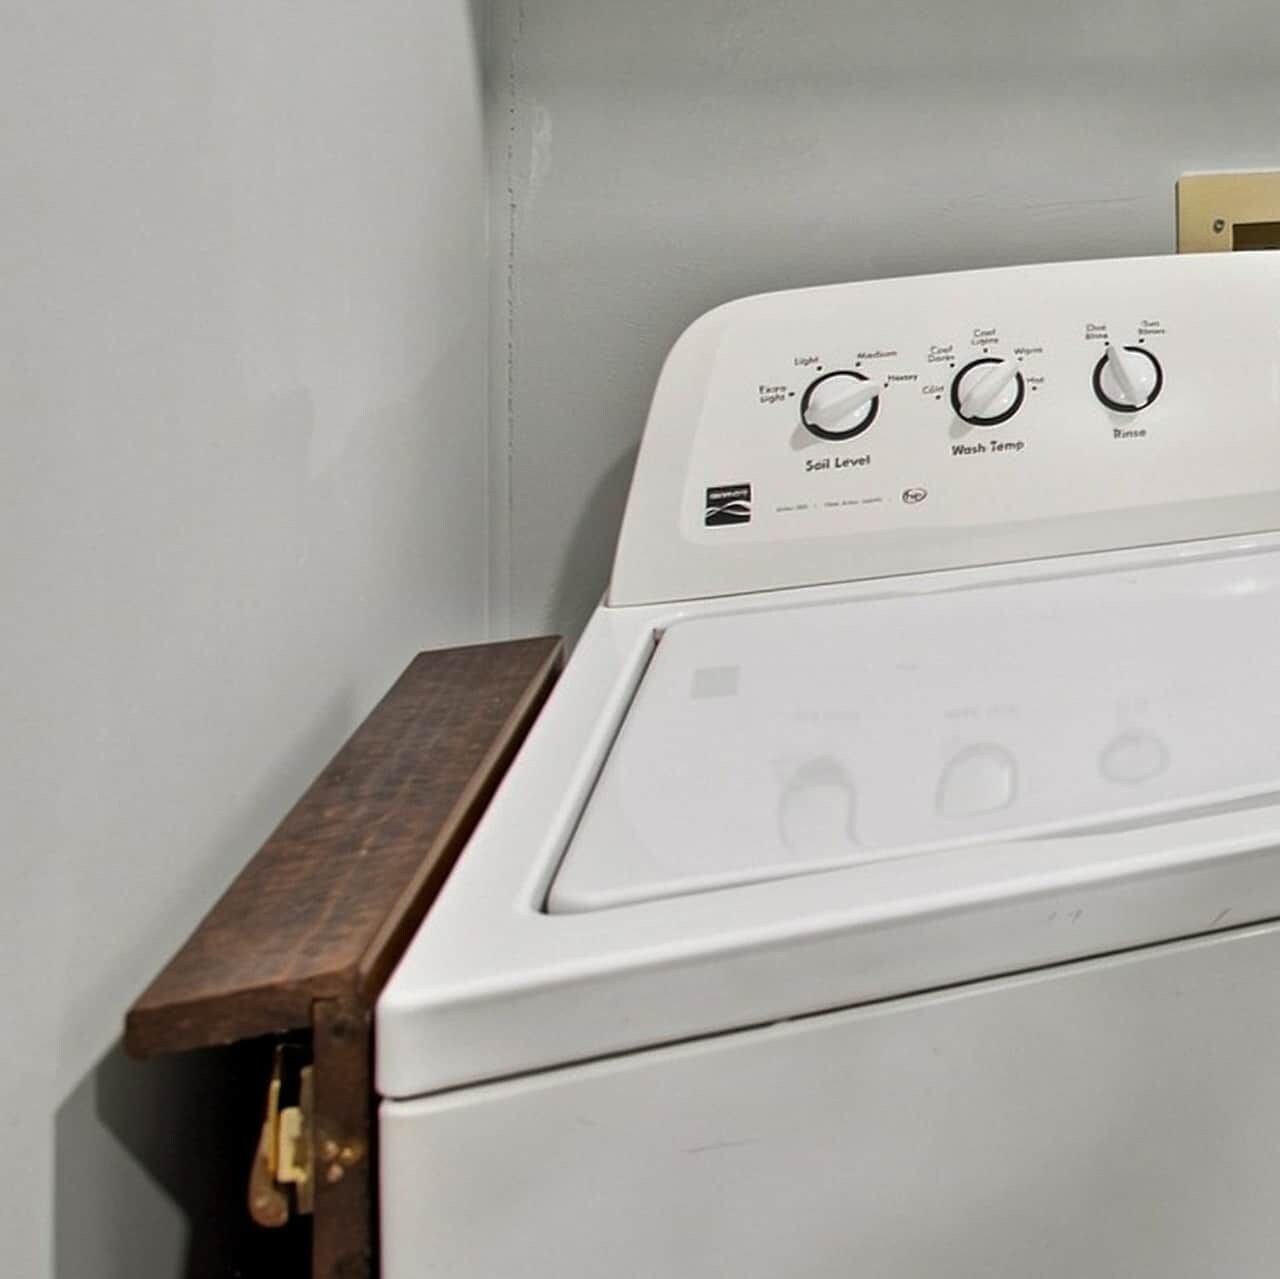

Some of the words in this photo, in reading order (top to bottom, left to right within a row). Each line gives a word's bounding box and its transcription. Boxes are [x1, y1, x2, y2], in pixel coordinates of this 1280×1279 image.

[793, 355, 820, 367] Light
[856, 350, 898, 360] Medium
[887, 373, 919, 383] Heavy
[921, 384, 945, 395] Cold
[1112, 427, 1148, 440] Rinse
[951, 443, 987, 456] Wash
[990, 439, 1025, 453] Temp
[804, 458, 831, 472] Soil
[834, 454, 872, 469] Level
